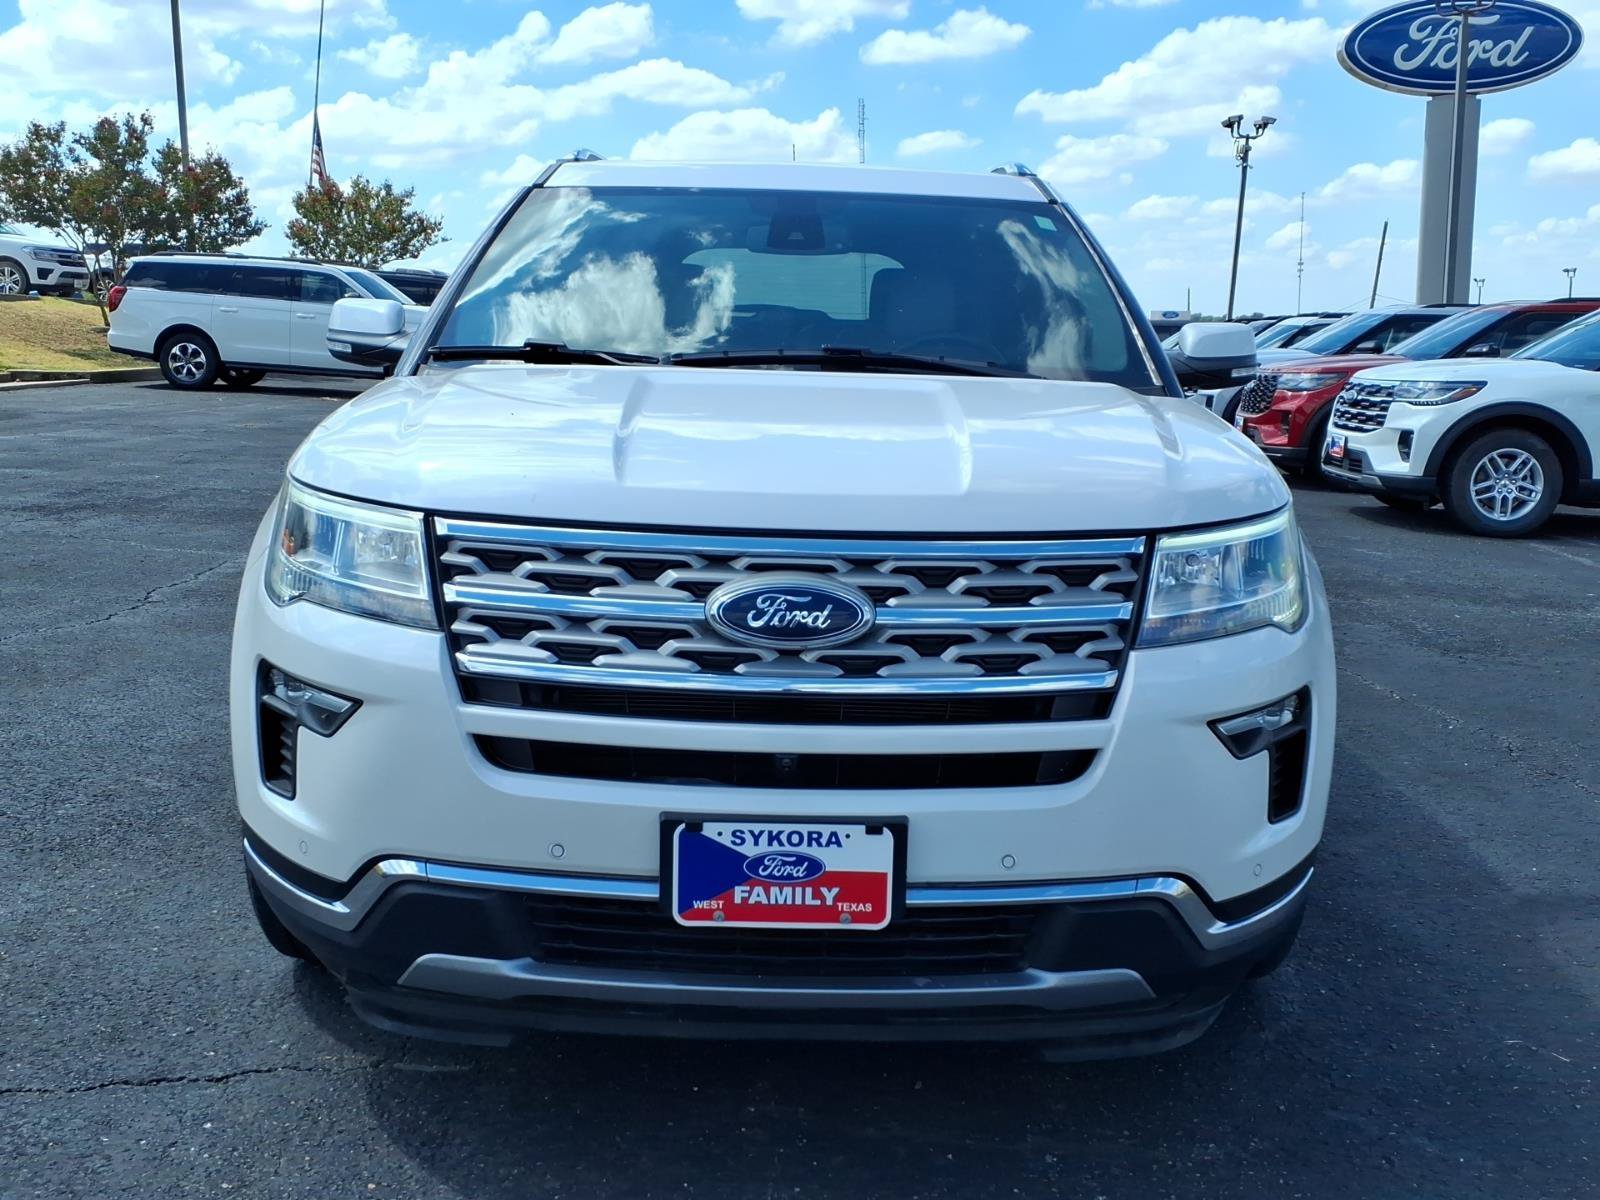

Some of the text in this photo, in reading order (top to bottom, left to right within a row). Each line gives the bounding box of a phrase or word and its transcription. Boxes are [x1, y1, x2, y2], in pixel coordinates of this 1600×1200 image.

[1393, 14, 1535, 71] Ford
[747, 593, 833, 629] Ford
[730, 829, 843, 848] SYKORA
[758, 855, 808, 877] Ford
[693, 900, 724, 909] WEST
[734, 886, 840, 906] FAMILY
[837, 902, 872, 912] TEXAS
